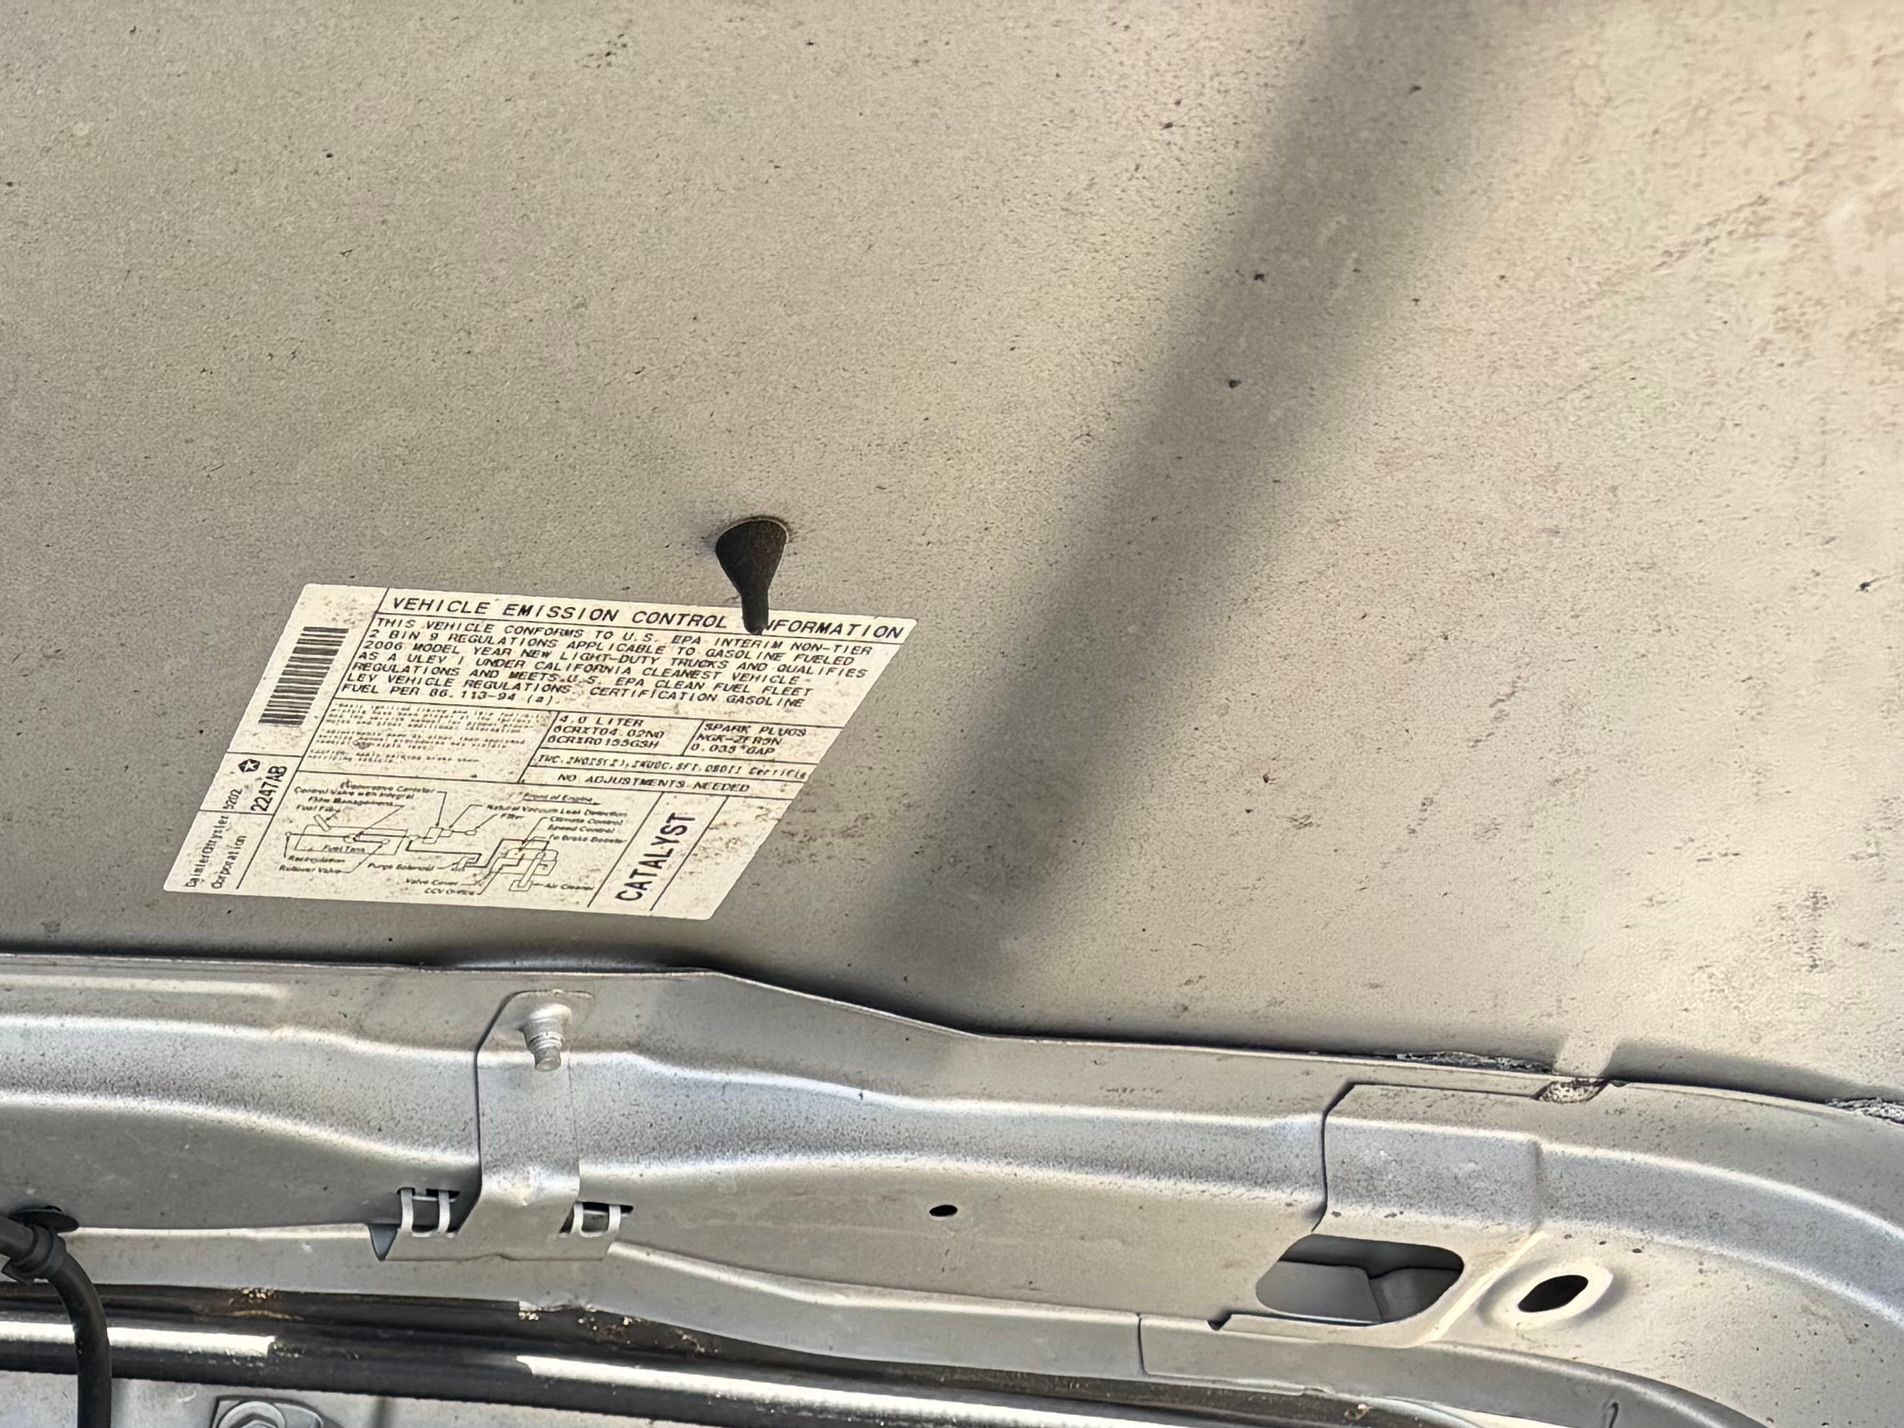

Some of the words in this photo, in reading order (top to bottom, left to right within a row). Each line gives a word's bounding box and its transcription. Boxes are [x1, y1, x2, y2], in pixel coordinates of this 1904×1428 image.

[376, 616, 417, 629] THIS
[425, 619, 496, 634] VEHICLE
[502, 623, 585, 639] CONFORMS
[594, 628, 615, 640] TO
[669, 633, 702, 645] EPA
[713, 636, 784, 649] INTERIM
[788, 640, 873, 656] NON-TIER
[392, 595, 491, 615] VEHICLE
[500, 602, 620, 623] EMISSION
[630, 609, 727, 629] CONTROL
[757, 617, 905, 639] NFORMATION
[361, 639, 404, 651] 2006
[410, 641, 461, 655] MODEL
[472, 644, 513, 657] YEAR
[518, 647, 553, 659] NEW
[558, 650, 661, 665] LIGHT-DUTY
[669, 656, 730, 670] TRUCKS
[734, 660, 769, 672] AND
[775, 662, 869, 679] QUALIFIES
[367, 627, 381, 639] 2
[387, 628, 421, 641] BIN
[446, 631, 559, 649] REGULATIONS
[564, 639, 667, 655] APPLICABLE
[676, 645, 696, 657] TO
[703, 647, 786, 662] GASOLINE
[791, 652, 855, 666] FUELED
[350, 660, 461, 677] REGULATIONS
[467, 667, 500, 679] AND
[506, 669, 561, 683] MEETS
[613, 675, 645, 687] EPA
[653, 678, 706, 691] CLEAN
[711, 681, 751, 694] FUEL
[760, 684, 814, 697] FLEET
[356, 650, 380, 661] AS
[386, 651, 397, 662] A
[474, 656, 526, 669] UNDER
[532, 659, 632, 675] CALIFORNIA
[640, 666, 723, 680] CLEANEST
[730, 671, 801, 686] VEHICLE
[339, 681, 379, 695] FUEL
[388, 684, 421, 696] PER
[386, 673, 456, 688] VEHICLE
[588, 685, 719, 703] CERTIFICATION
[724, 693, 806, 708] GASOLINE
[594, 715, 645, 728] LITER
[702, 721, 752, 735] SPARK
[757, 724, 807, 737] PLUGS
[248, 764, 288, 813] 2247AB
[556, 772, 577, 783] NO
[583, 774, 686, 789] ADJUSTMENTS
[690, 780, 751, 793] NEEDED
[209, 834, 248, 890] Corporation
[613, 810, 696, 902] CATALYST
